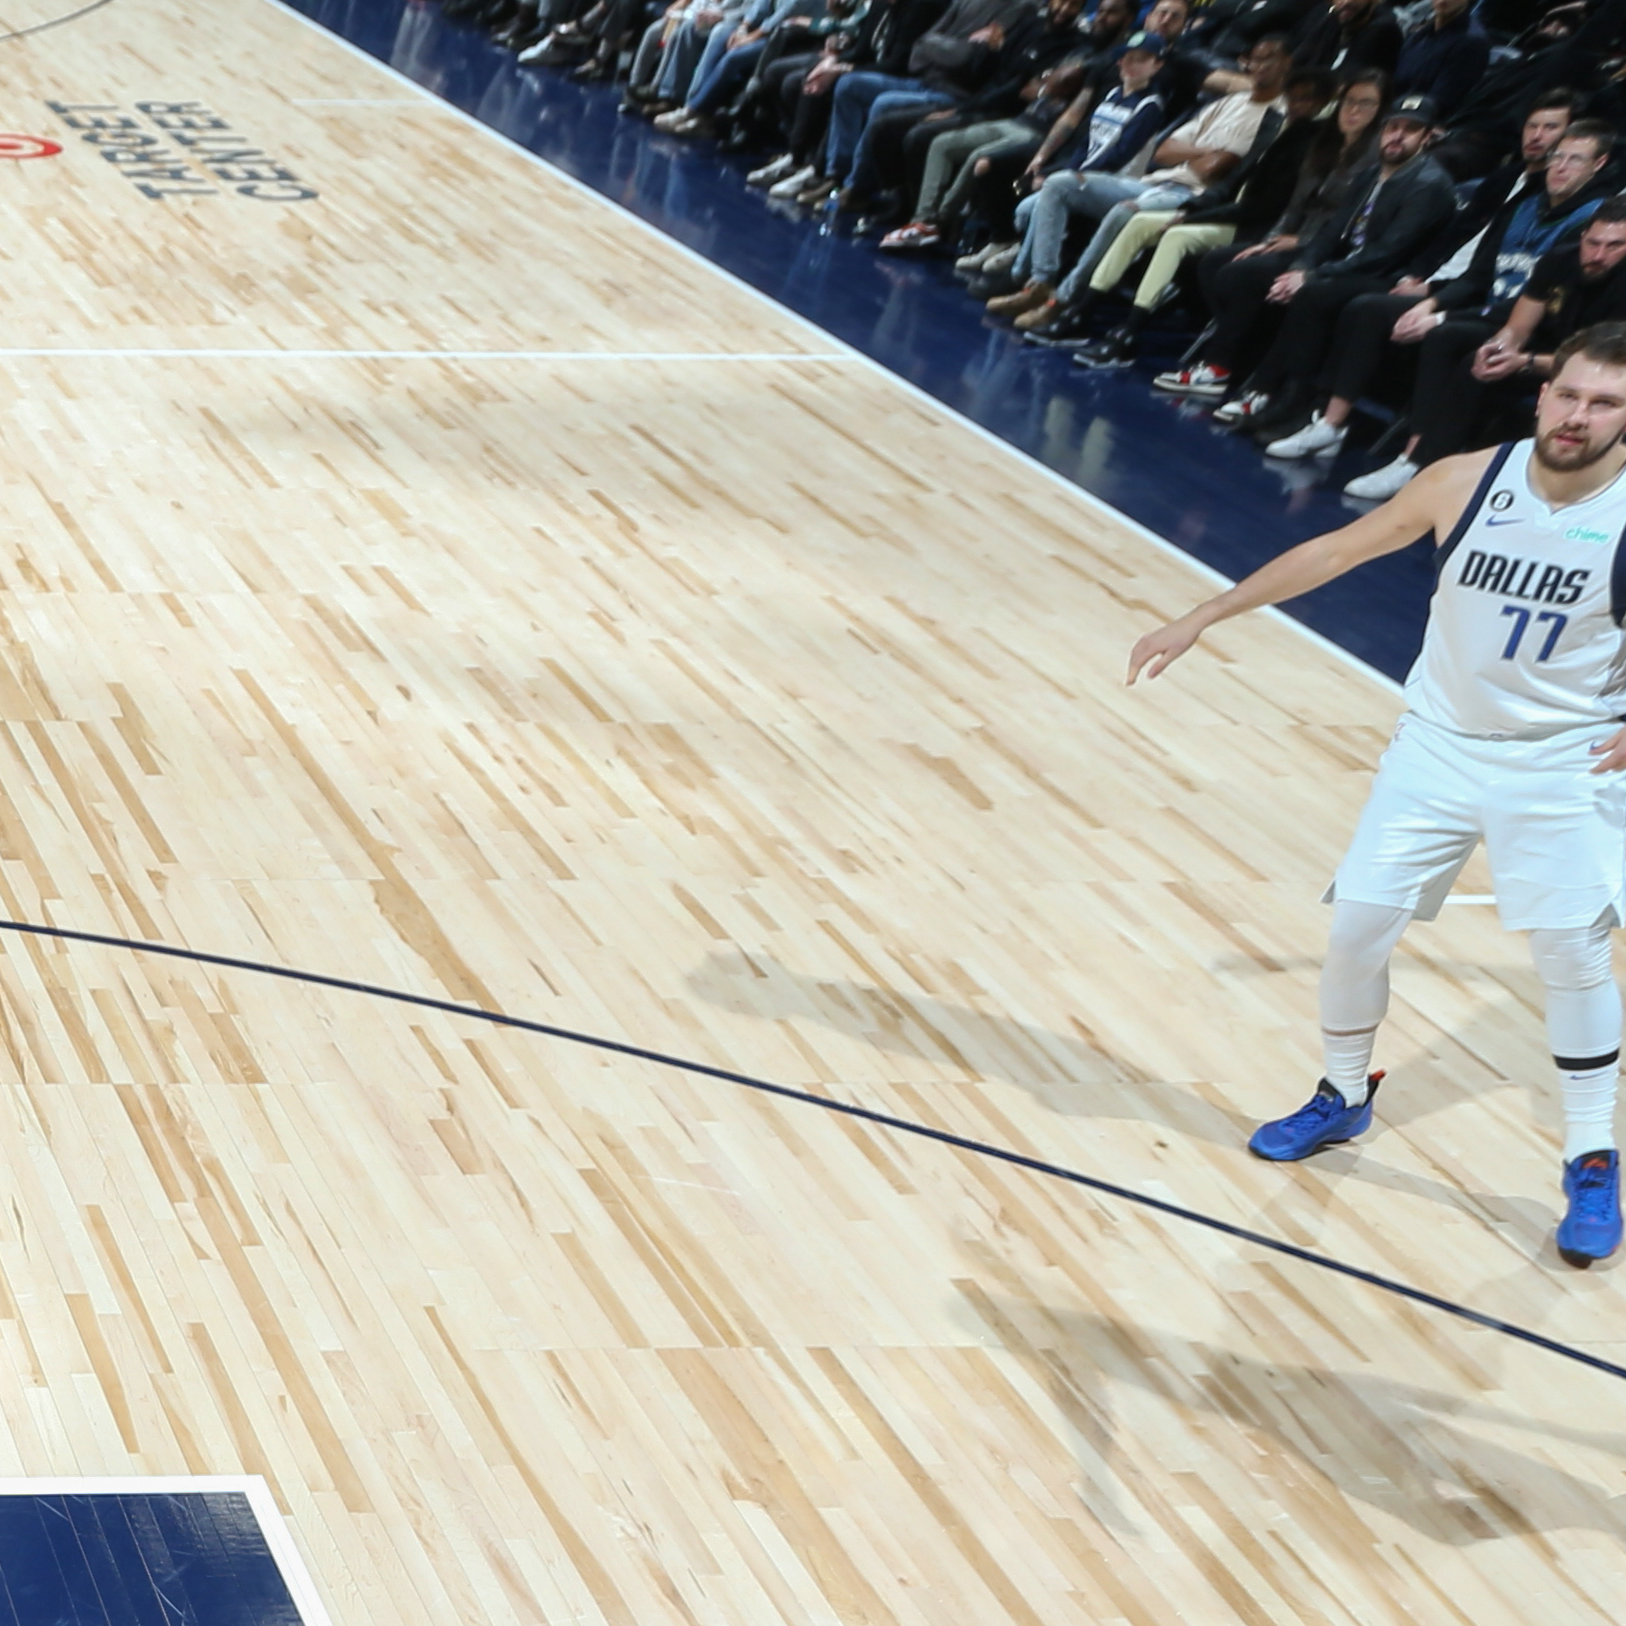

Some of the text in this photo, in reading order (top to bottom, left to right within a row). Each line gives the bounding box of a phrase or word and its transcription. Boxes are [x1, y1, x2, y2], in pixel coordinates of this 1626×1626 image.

[44, 100, 220, 199] TARGET
[135, 101, 320, 201] CENTER
[1457, 549, 1592, 605] DALLAS
[1500, 604, 1569, 663] 77
